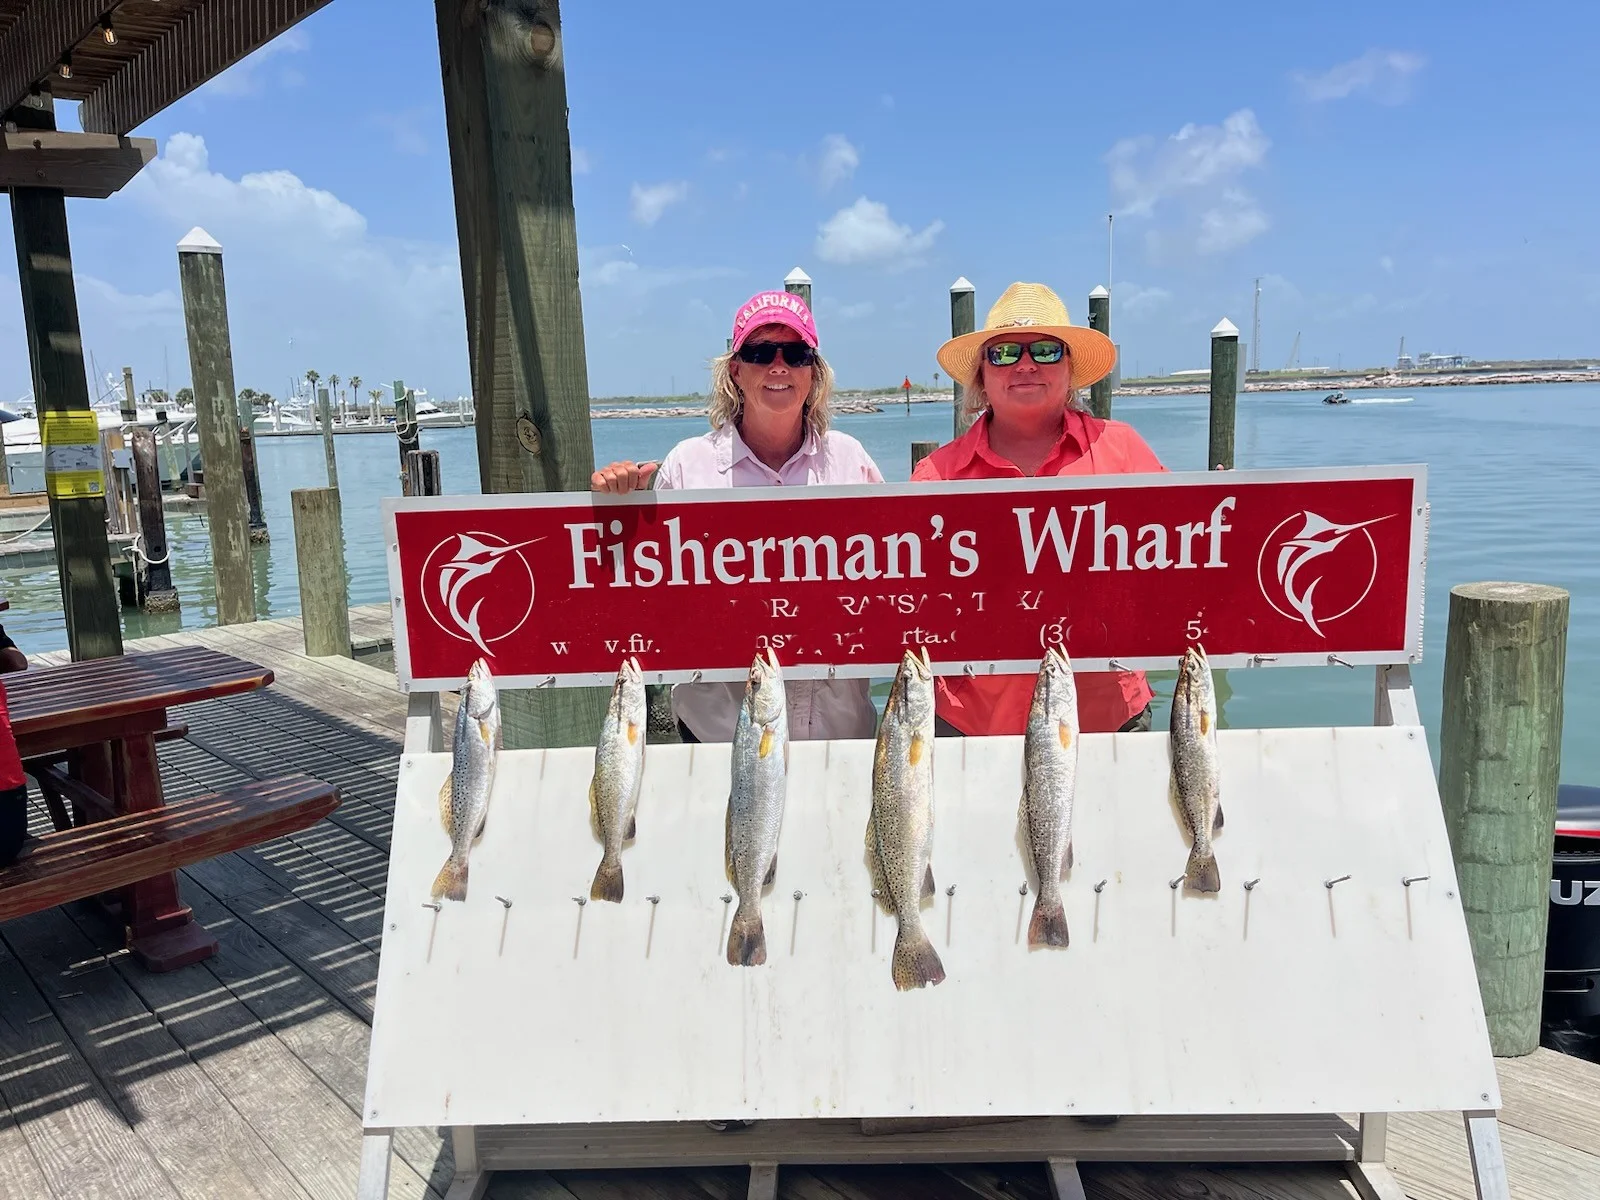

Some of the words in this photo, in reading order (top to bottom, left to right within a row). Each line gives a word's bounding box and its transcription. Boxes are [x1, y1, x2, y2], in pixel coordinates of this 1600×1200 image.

[736, 294, 809, 328] CALIFORNIA
[563, 515, 980, 590] Fisherman's
[1012, 496, 1236, 575] Wharf
